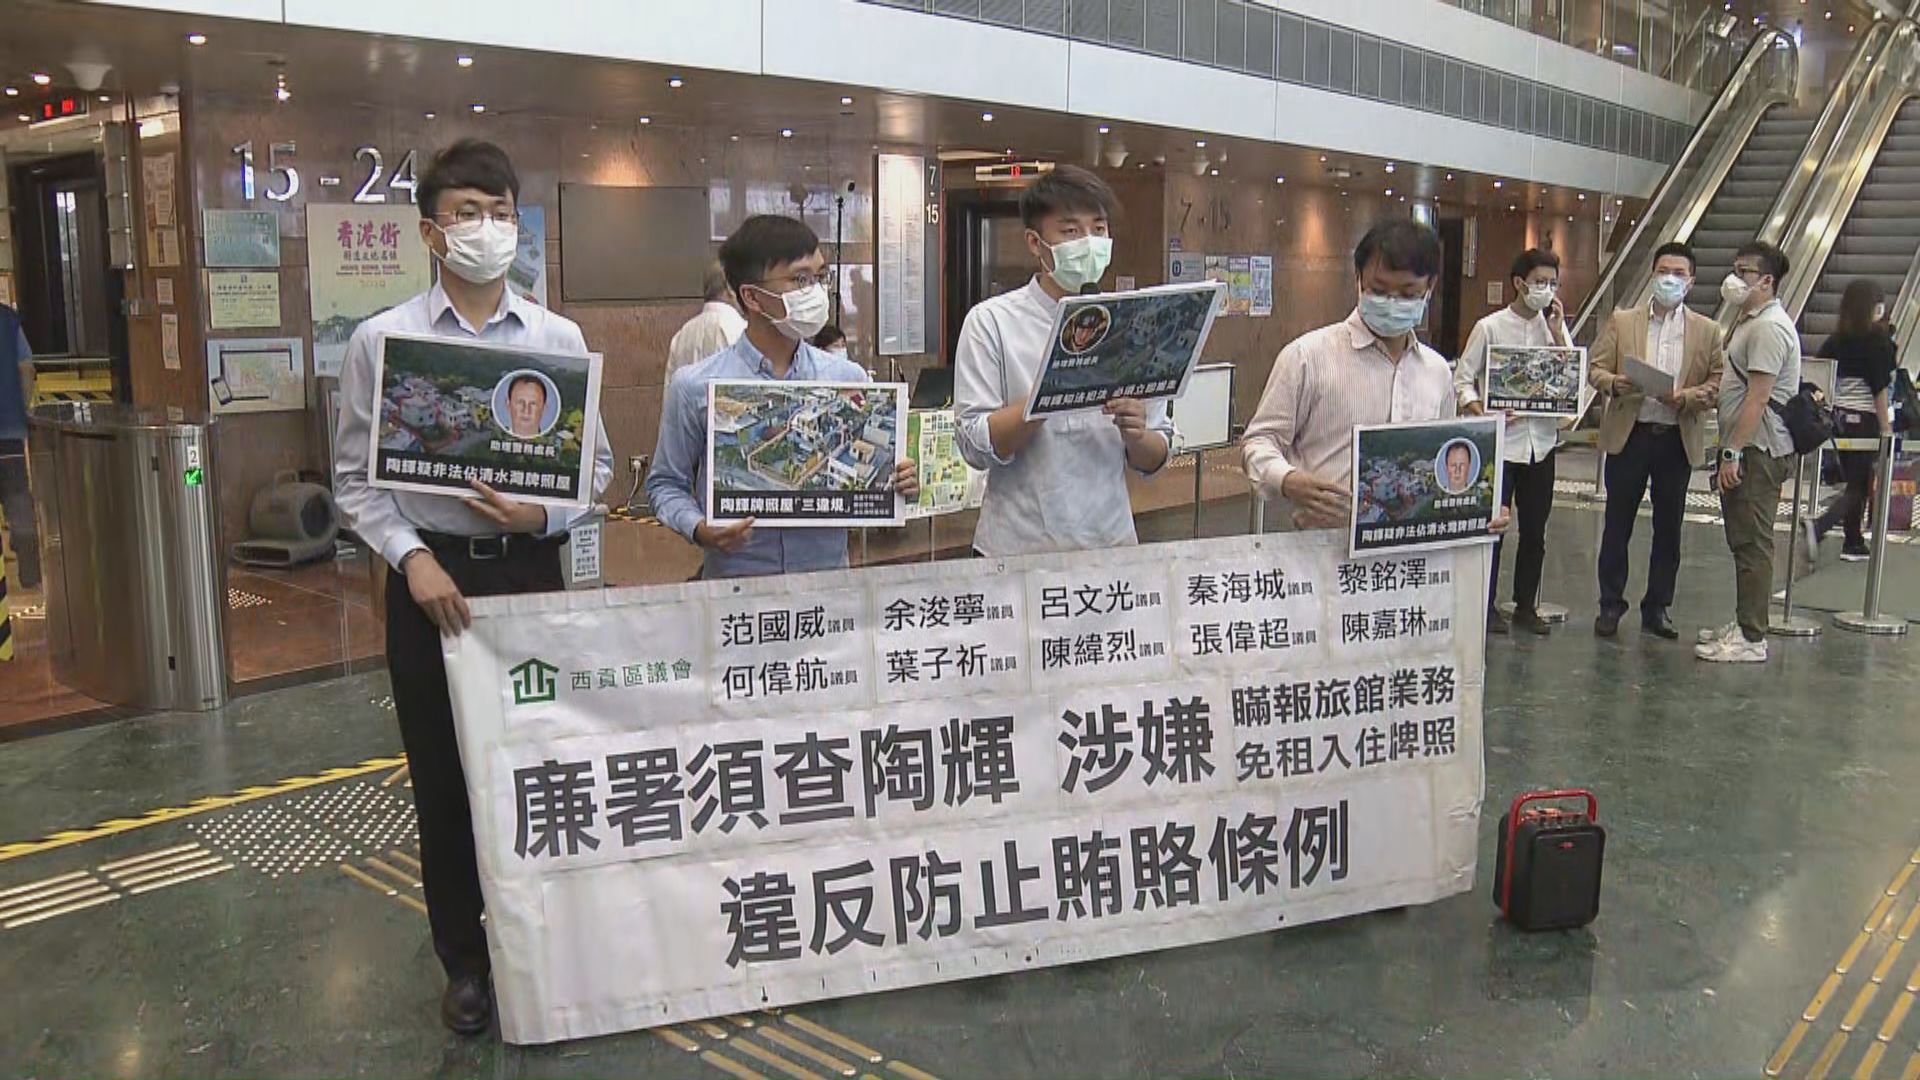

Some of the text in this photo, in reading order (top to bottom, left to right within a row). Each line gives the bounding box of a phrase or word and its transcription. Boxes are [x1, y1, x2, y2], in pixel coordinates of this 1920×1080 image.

[233, 140, 299, 201] 15
[353, 147, 418, 203] 24
[929, 166, 936, 185] 7
[926, 203, 939, 224] 15
[190, 450, 198, 463] 2
[386, 457, 571, 491] 陶輝疑非法佔清水灣牌照屋
[721, 606, 855, 647] 范國威議員
[1041, 580, 1161, 619] 呂文光議員
[1187, 568, 1313, 606] 秦海城議員
[570, 658, 692, 691] 西貢區議會
[722, 657, 858, 699] 何偉航議員
[1190, 617, 1317, 656] 張偉超議員
[1341, 605, 1450, 644] 陳嘉琳議員
[1231, 665, 1456, 727] 瞞報旅館業務
[513, 695, 1216, 859] 廉署須查陶輝 涉嫌
[1235, 716, 1457, 783] 免租入住牌照
[720, 799, 1349, 968] 違反防止賄賂條例
